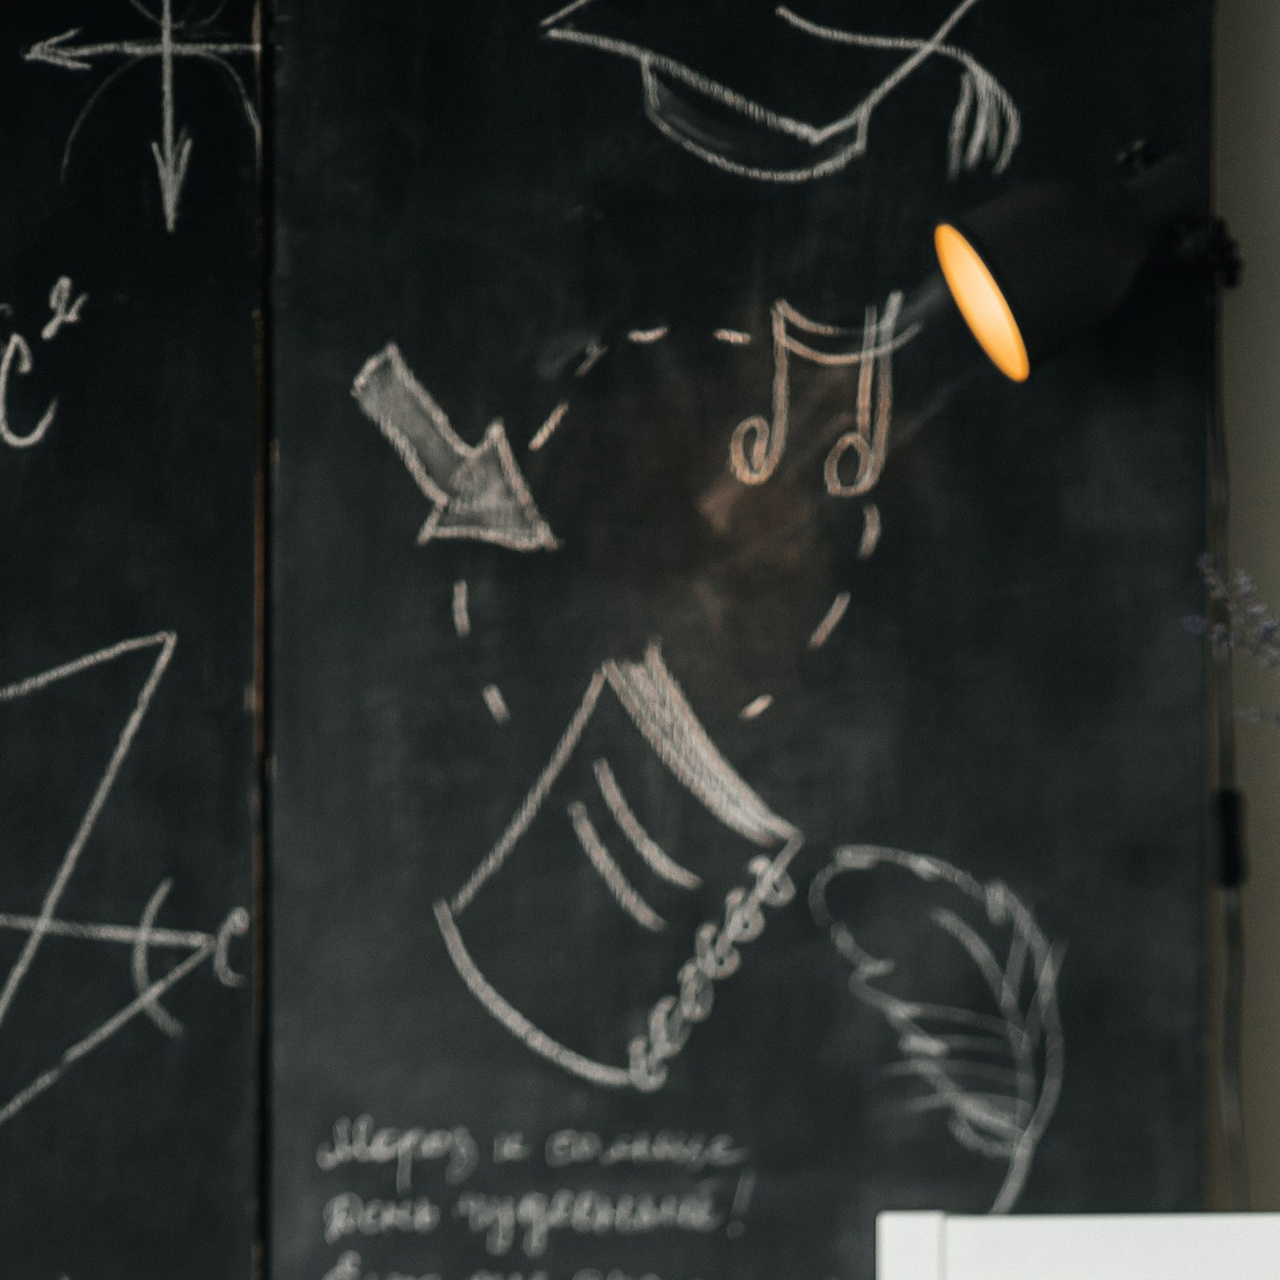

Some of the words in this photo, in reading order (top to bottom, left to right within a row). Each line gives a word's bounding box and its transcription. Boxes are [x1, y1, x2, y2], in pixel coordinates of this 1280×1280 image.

[316, 1113, 479, 1192] Мороз
[494, 1131, 533, 1167] и
[322, 1191, 442, 1245] День
